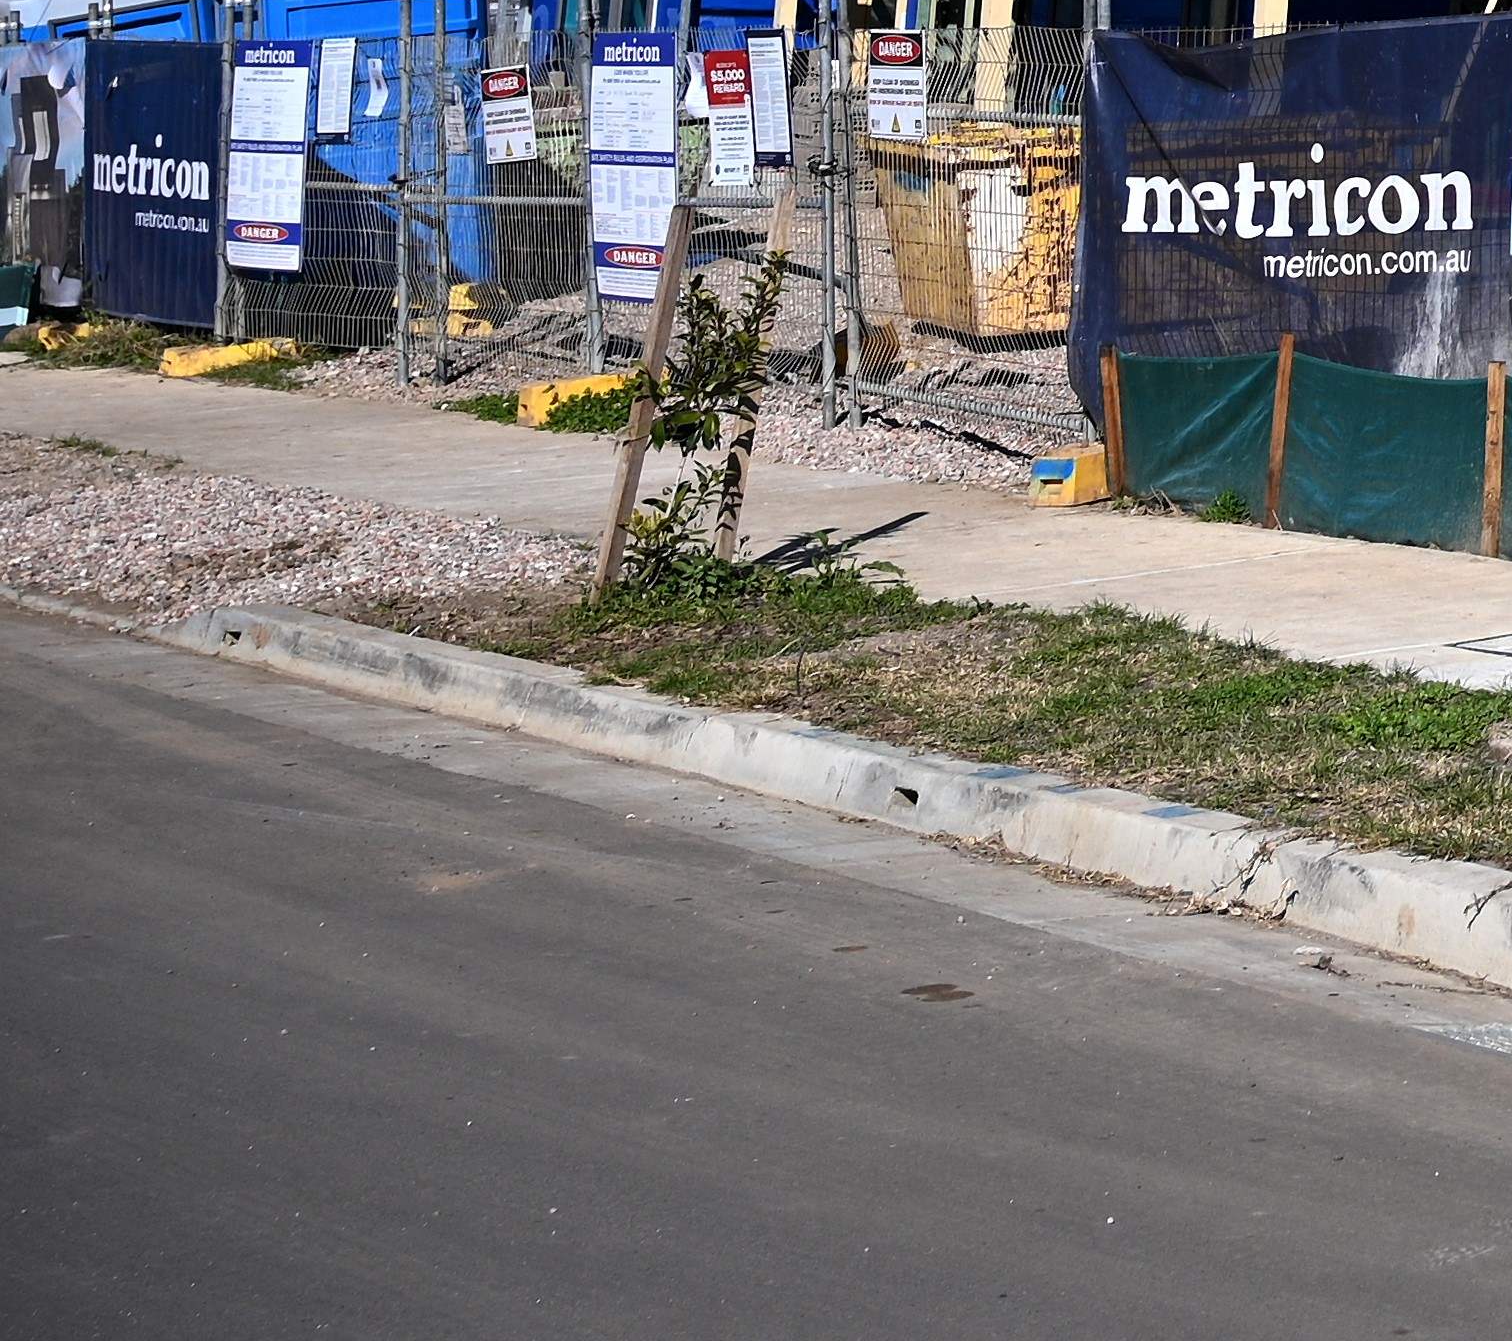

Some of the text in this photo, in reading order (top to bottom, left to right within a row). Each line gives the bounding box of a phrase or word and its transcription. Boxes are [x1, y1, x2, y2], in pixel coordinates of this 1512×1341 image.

[244, 42, 295, 64] metricon
[603, 36, 661, 62] metricon
[878, 41, 913, 57] DANGER
[710, 68, 746, 84] $5,000
[93, 133, 210, 201] metricon
[1121, 142, 1474, 240] metricon
[240, 226, 280, 239] DANGER
[613, 250, 657, 265] DANGER
[1263, 247, 1472, 279] metricon.com.au
